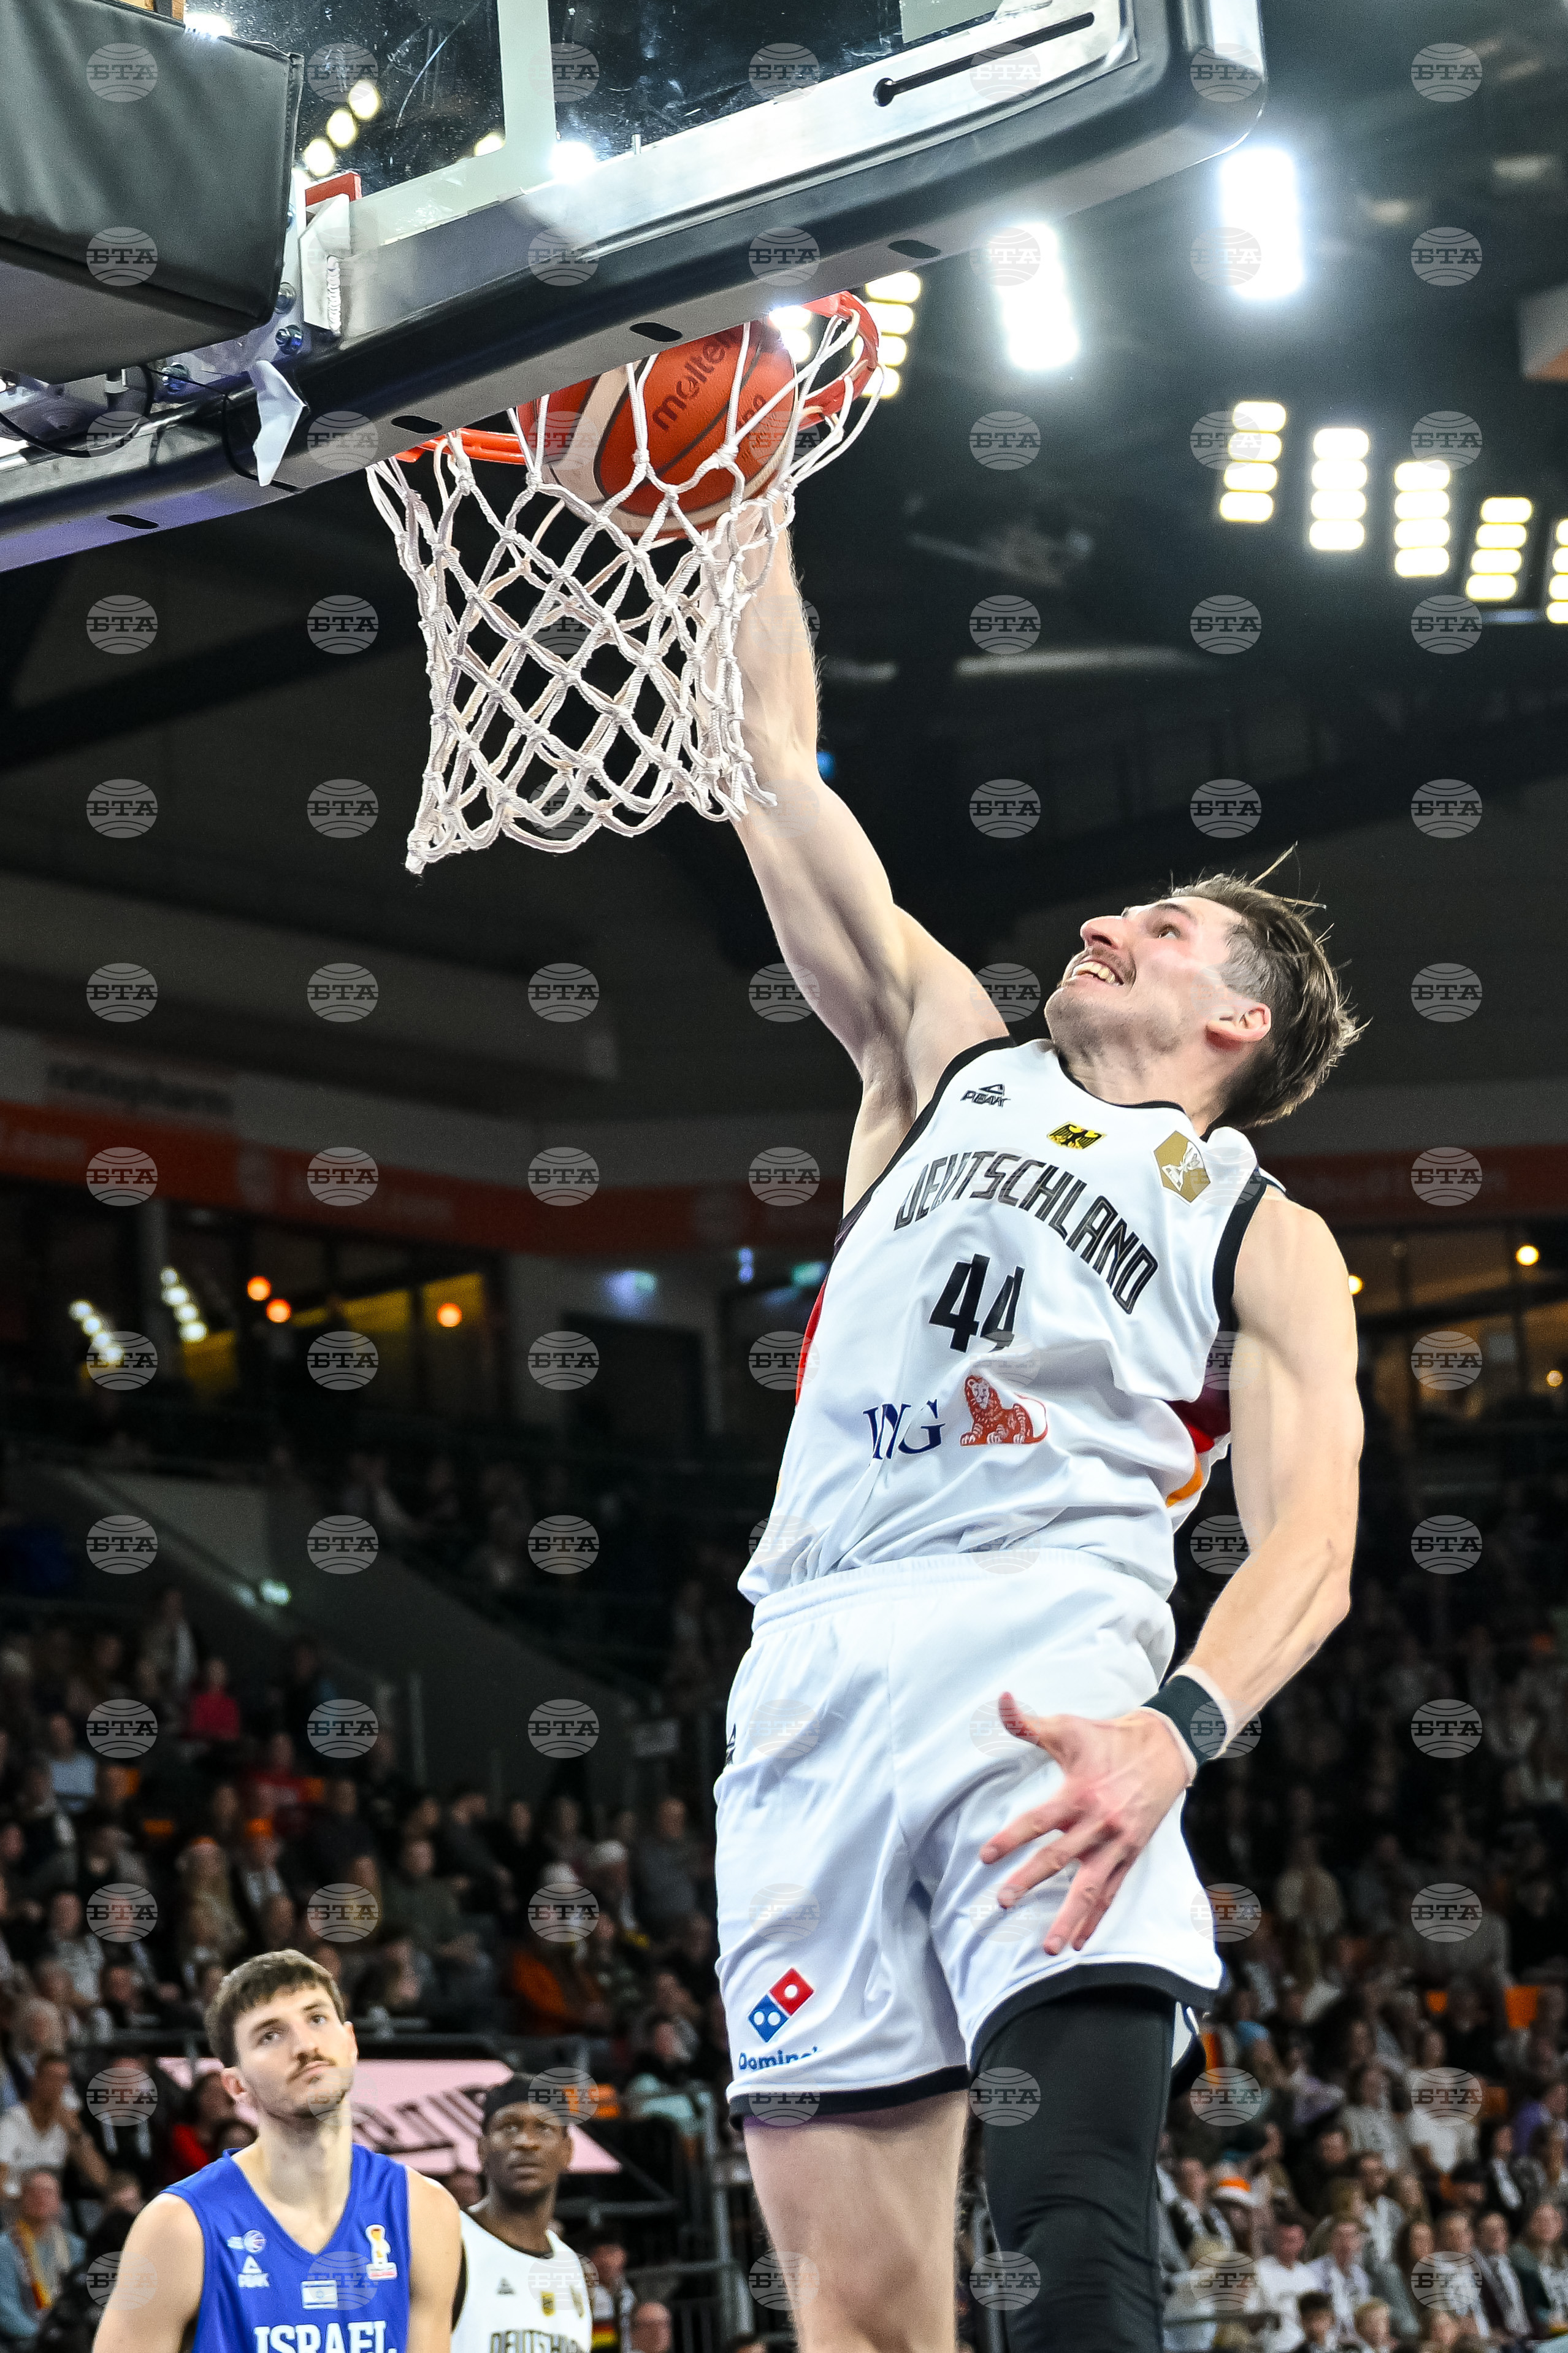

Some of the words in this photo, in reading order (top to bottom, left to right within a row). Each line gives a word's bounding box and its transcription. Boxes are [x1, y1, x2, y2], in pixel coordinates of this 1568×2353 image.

[893, 1151, 1158, 1315] DEUTSCHLAND
[928, 1253, 1025, 1353] 44
[254, 2320, 397, 2353] ISRAEL
